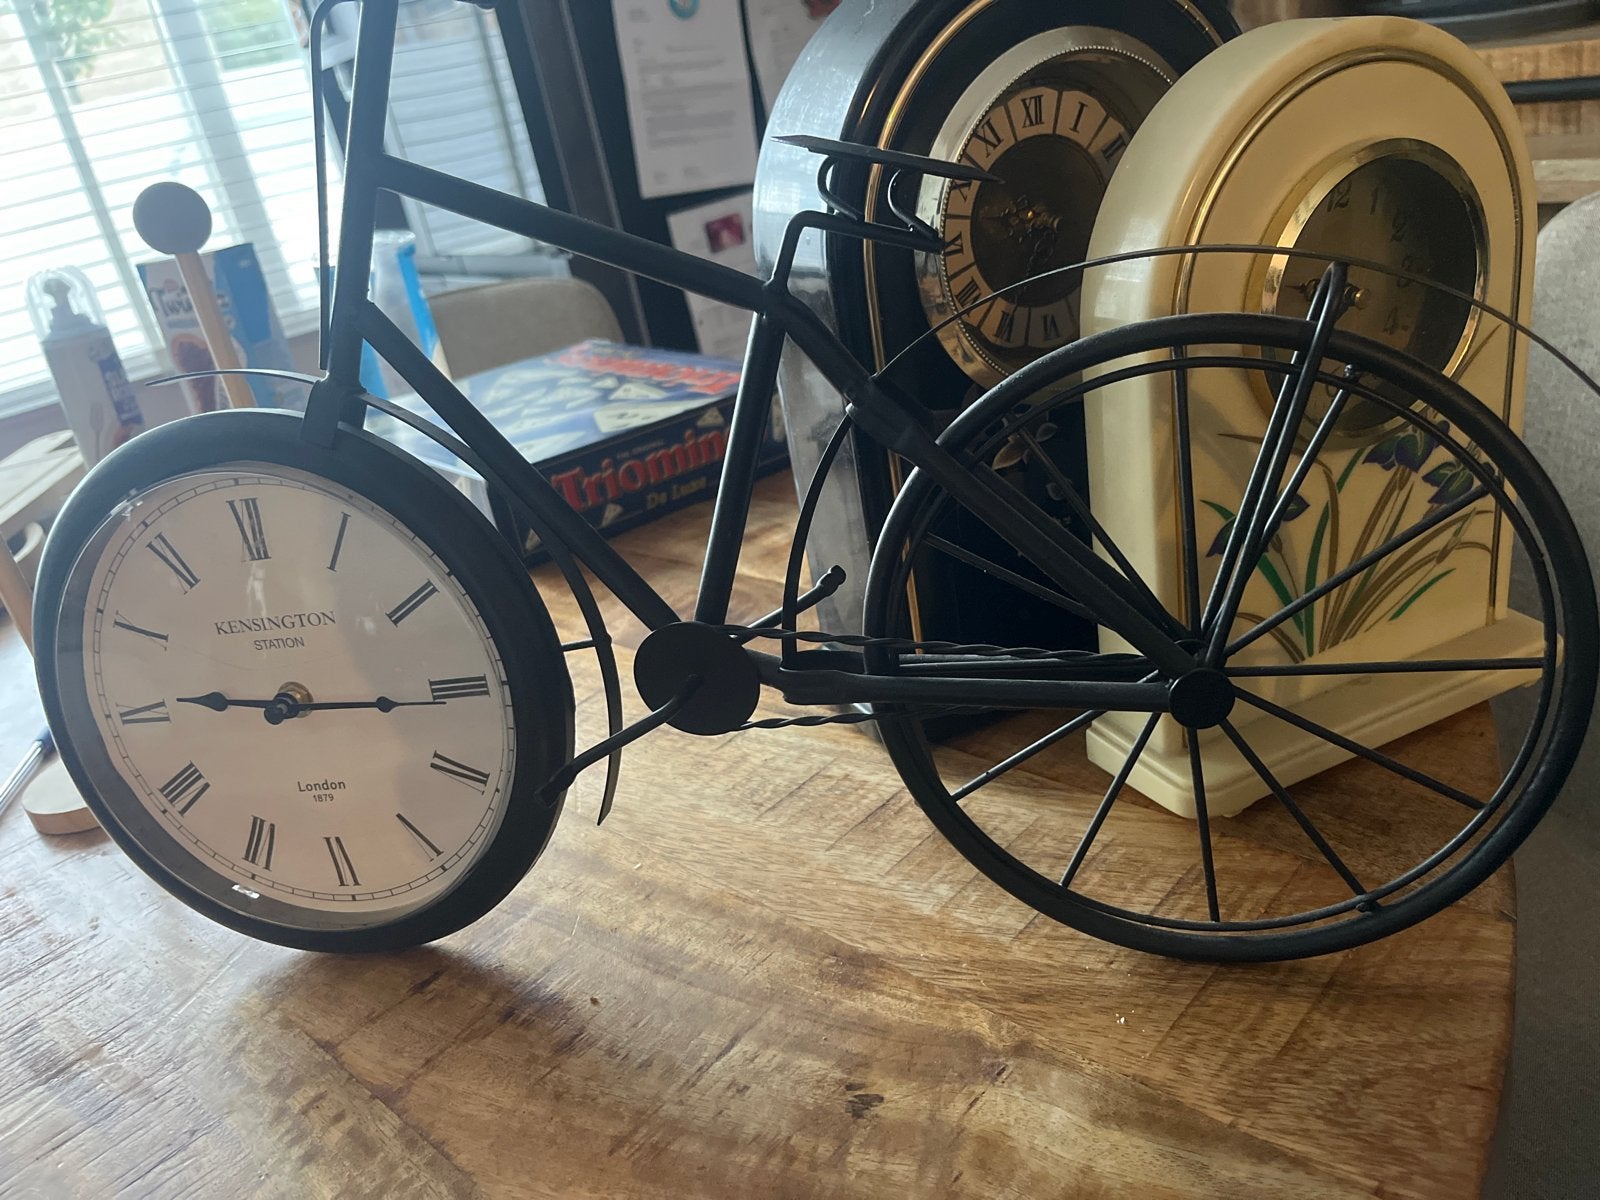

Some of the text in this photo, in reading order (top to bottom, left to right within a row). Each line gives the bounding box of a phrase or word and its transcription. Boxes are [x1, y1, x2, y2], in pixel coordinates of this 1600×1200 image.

[1020, 94, 1045, 129] XII
[1068, 101, 1089, 134] I
[973, 117, 1004, 159] XI
[1326, 178, 1352, 212] 12
[551, 427, 742, 512] Triomin
[227, 498, 271, 562] XII
[327, 512, 351, 572] I
[146, 533, 200, 594] XI
[214, 611, 336, 635] KENSINGTON
[385, 580, 440, 627] II
[113, 610, 169, 651] X
[253, 636, 305, 651] STATION
[428, 674, 491, 701] III
[116, 699, 172, 725] IX
[158, 760, 211, 817] VIII
[297, 779, 346, 792] London
[430, 750, 491, 795] IV
[242, 815, 276, 871] VII
[396, 813, 444, 862] V
[322, 836, 362, 887] VI
